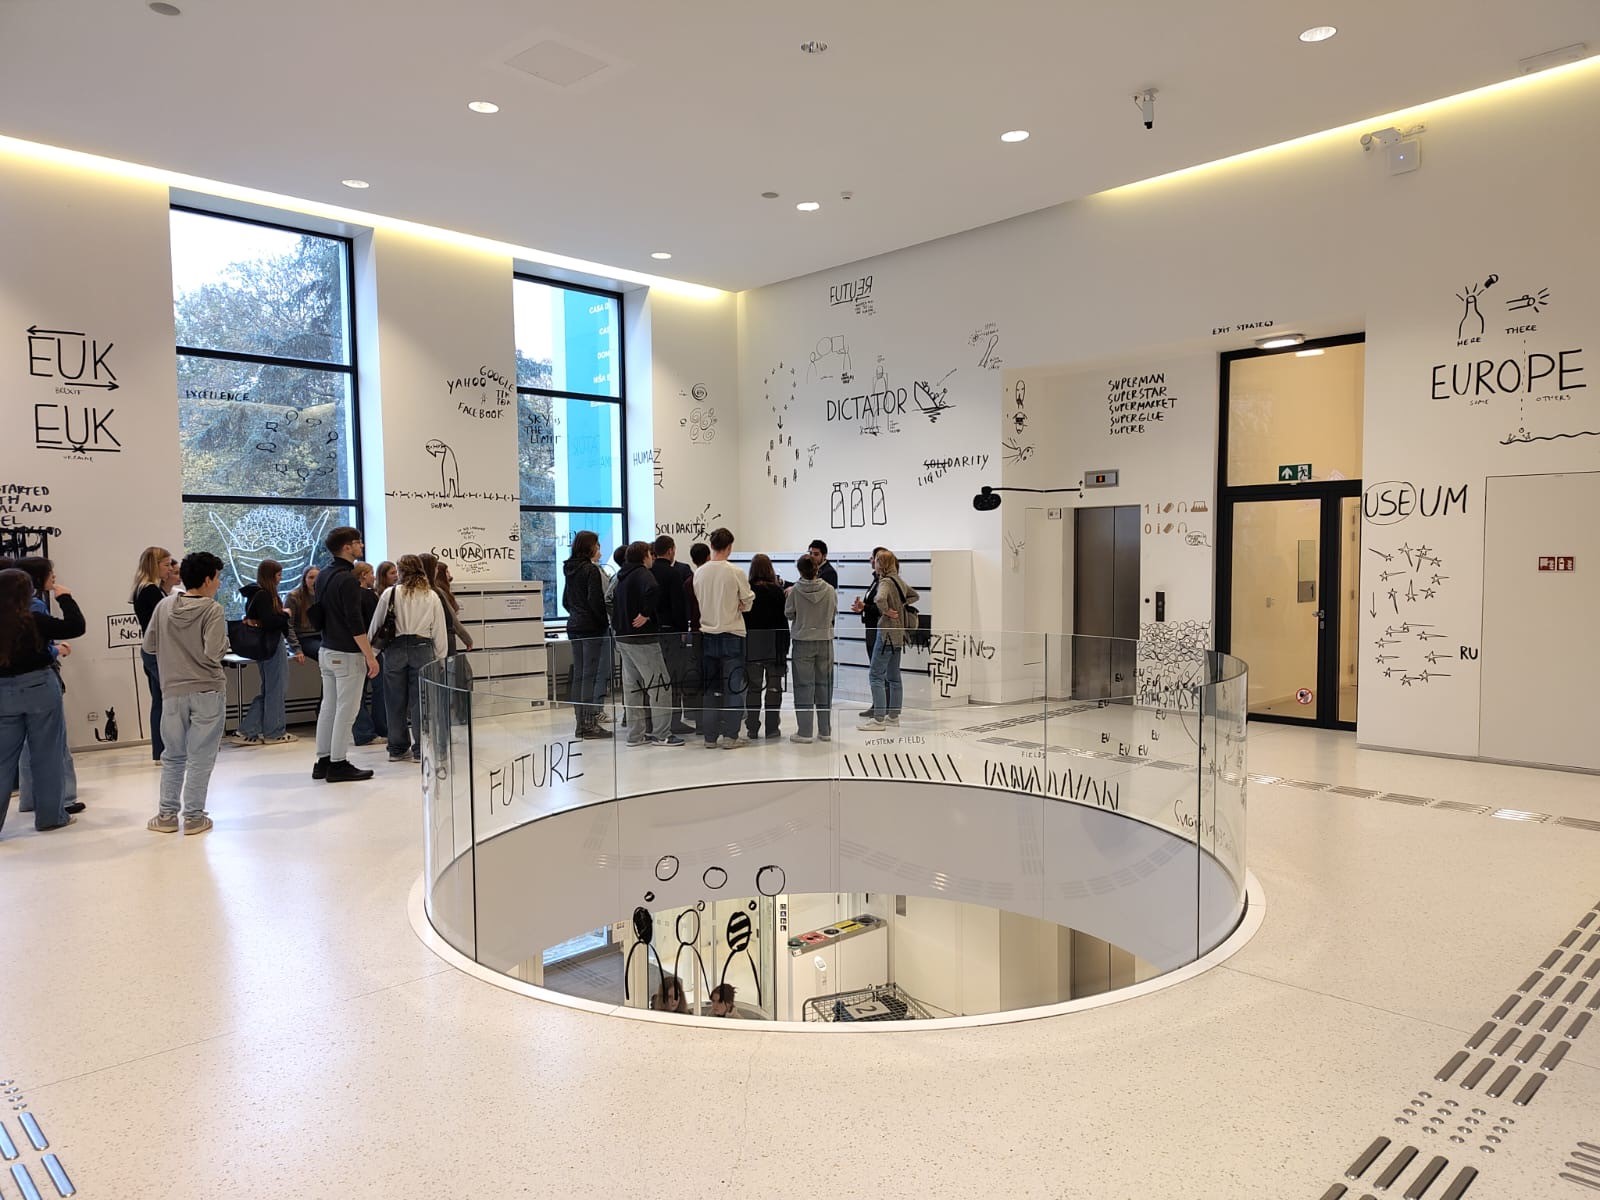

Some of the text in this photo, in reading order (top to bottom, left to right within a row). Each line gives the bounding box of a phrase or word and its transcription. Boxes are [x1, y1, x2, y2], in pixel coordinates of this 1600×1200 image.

[1505, 325, 1537, 334] THERE
[1457, 336, 1481, 347] HERE
[28, 335, 117, 380] EUK
[1108, 372, 1165, 392] SUPERMAN
[1432, 348, 1587, 400] EUROPE
[446, 377, 487, 395] YAHOO
[1107, 386, 1168, 405] SUPERSTAR
[1536, 394, 1572, 402] OTHERS
[826, 387, 908, 421] DICTATOR
[1108, 398, 1178, 415] SUPERMARKET
[34, 403, 121, 447] EUK
[527, 413, 550, 427] SKY
[1110, 411, 1165, 428] SUPERGLUE
[1109, 424, 1146, 436] SUPERB
[430, 546, 516, 561] SOLIDARITATE
[110, 615, 139, 627] HUMA
[1460, 645, 1479, 661] RU
[1155, 708, 1167, 721] EU
[899, 736, 926, 745] FIELDS
[1118, 742, 1149, 757] EU EU
[489, 739, 585, 815] FUTURE
